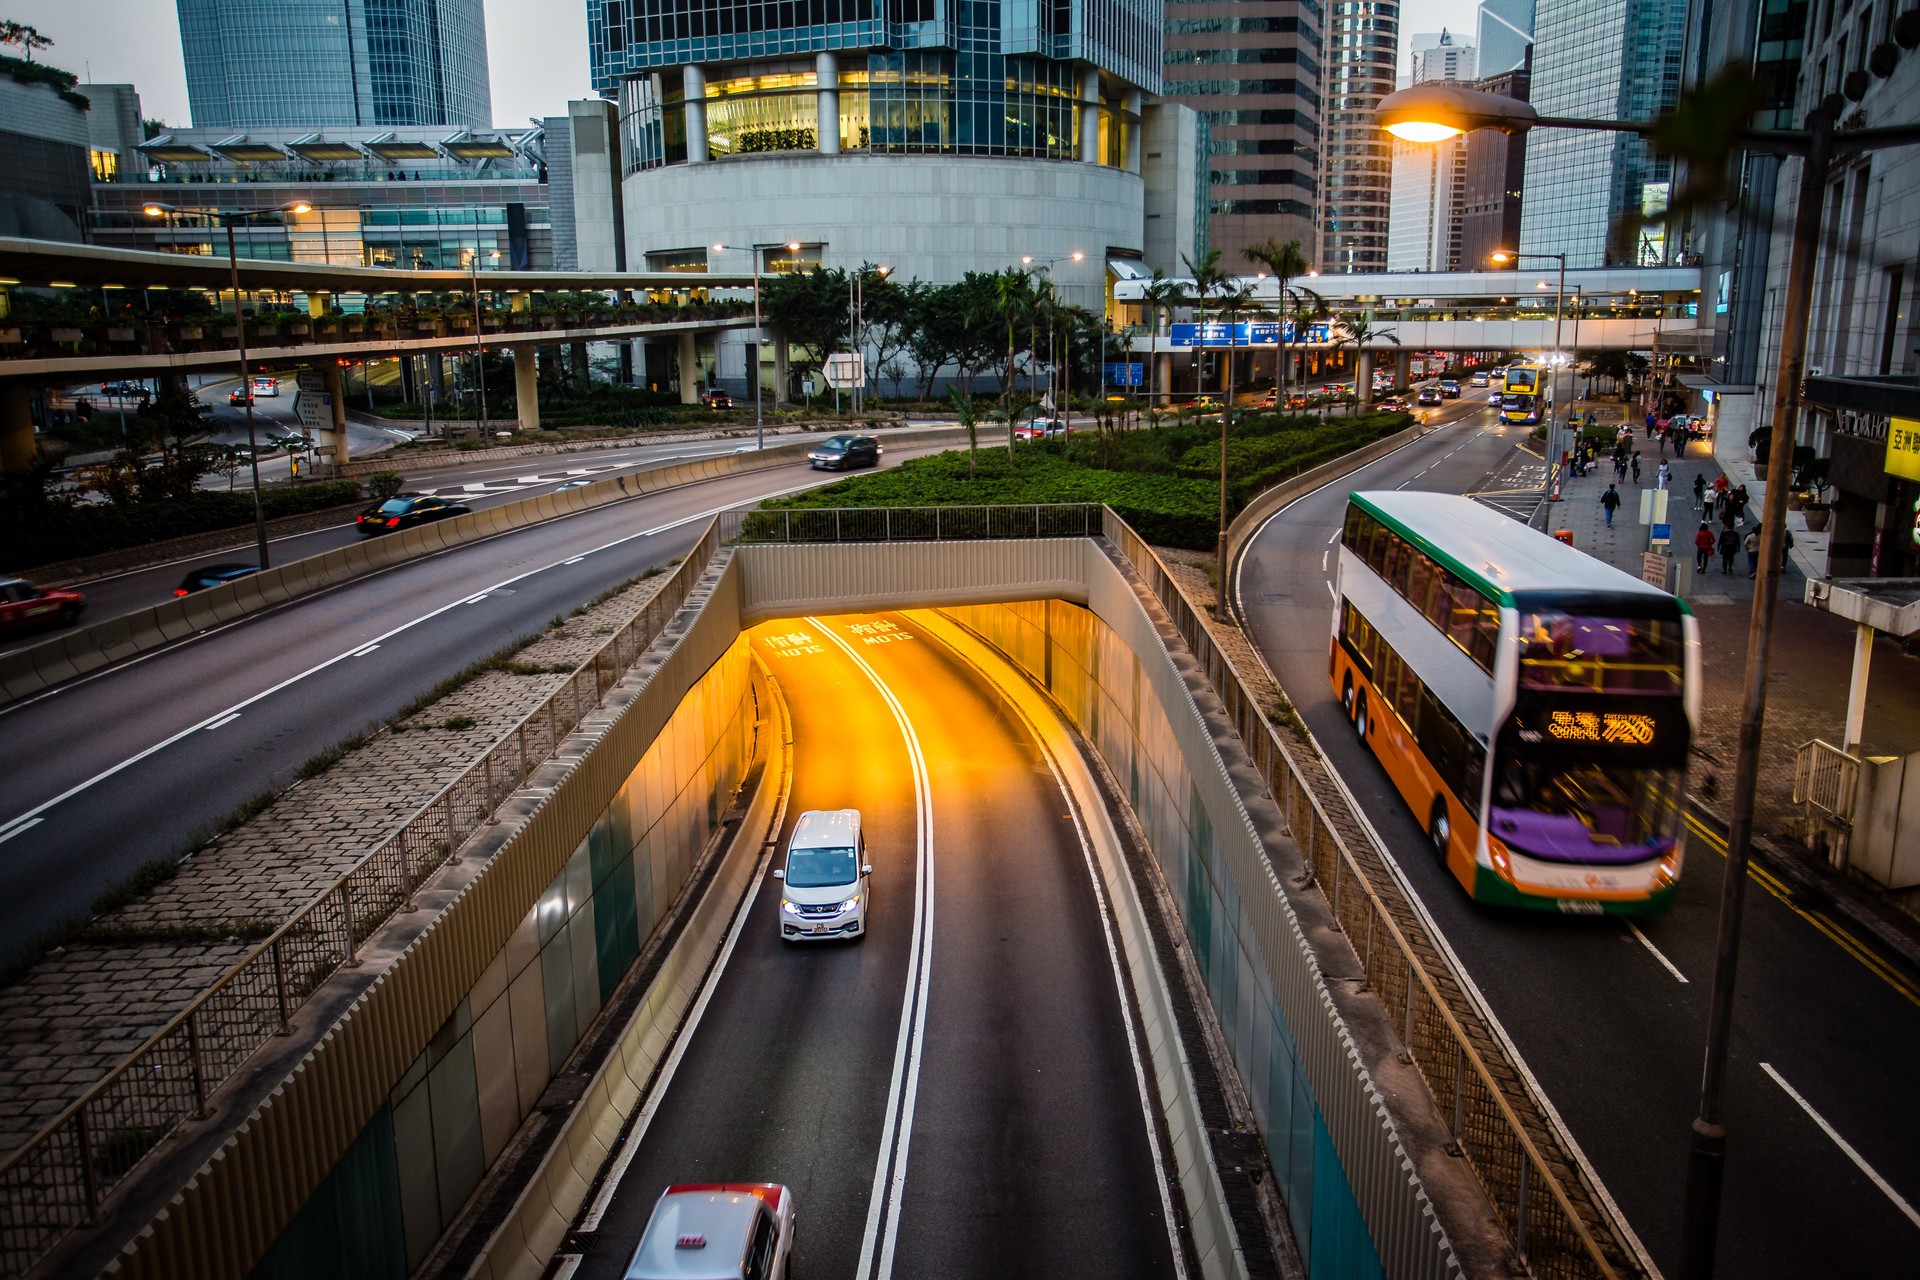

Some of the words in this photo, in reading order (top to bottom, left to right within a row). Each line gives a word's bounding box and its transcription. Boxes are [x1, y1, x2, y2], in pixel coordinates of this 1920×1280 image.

[862, 631, 914, 645] SLOW
[1548, 723, 1601, 741] Central
[1602, 718, 1655, 745] 720
